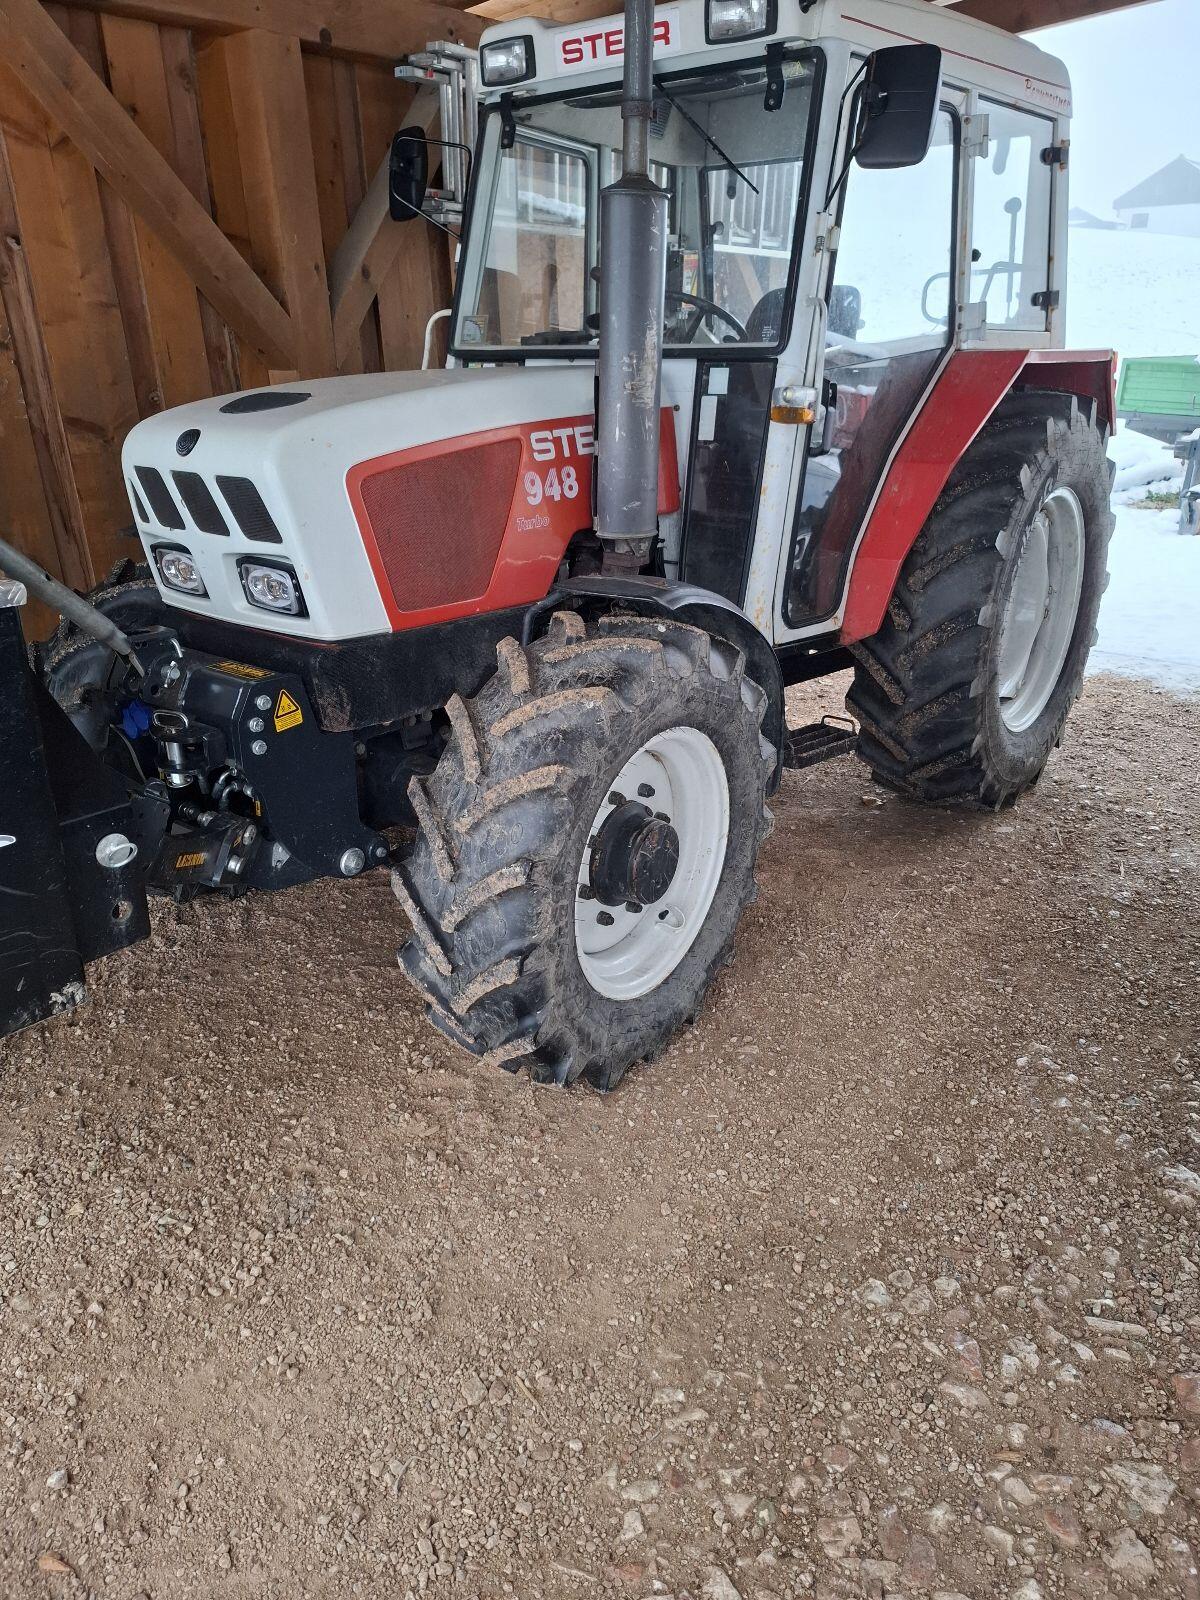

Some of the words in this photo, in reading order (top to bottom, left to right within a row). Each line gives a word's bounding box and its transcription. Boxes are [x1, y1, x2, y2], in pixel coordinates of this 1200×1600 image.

[562, 20, 671, 65] STER
[524, 465, 579, 506] 948
[516, 514, 550, 531] Turbo
